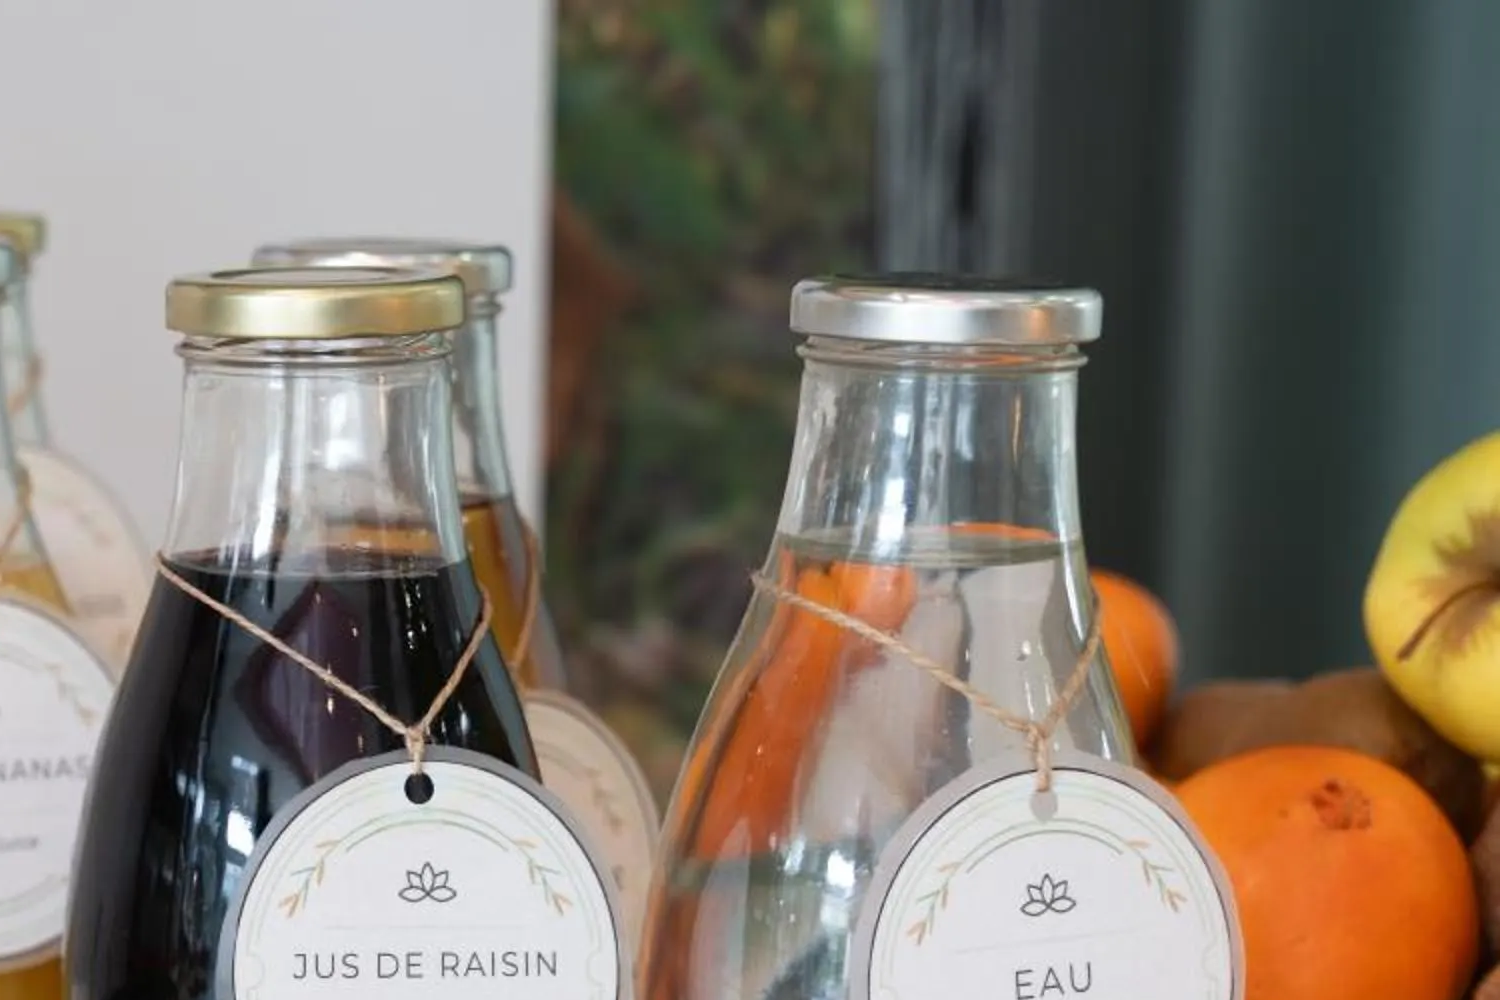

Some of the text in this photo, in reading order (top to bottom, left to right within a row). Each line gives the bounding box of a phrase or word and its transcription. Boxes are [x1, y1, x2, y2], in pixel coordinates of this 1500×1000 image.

[292, 951, 558, 980] JUS DE RAISIN
[1014, 961, 1092, 1000] EAU
